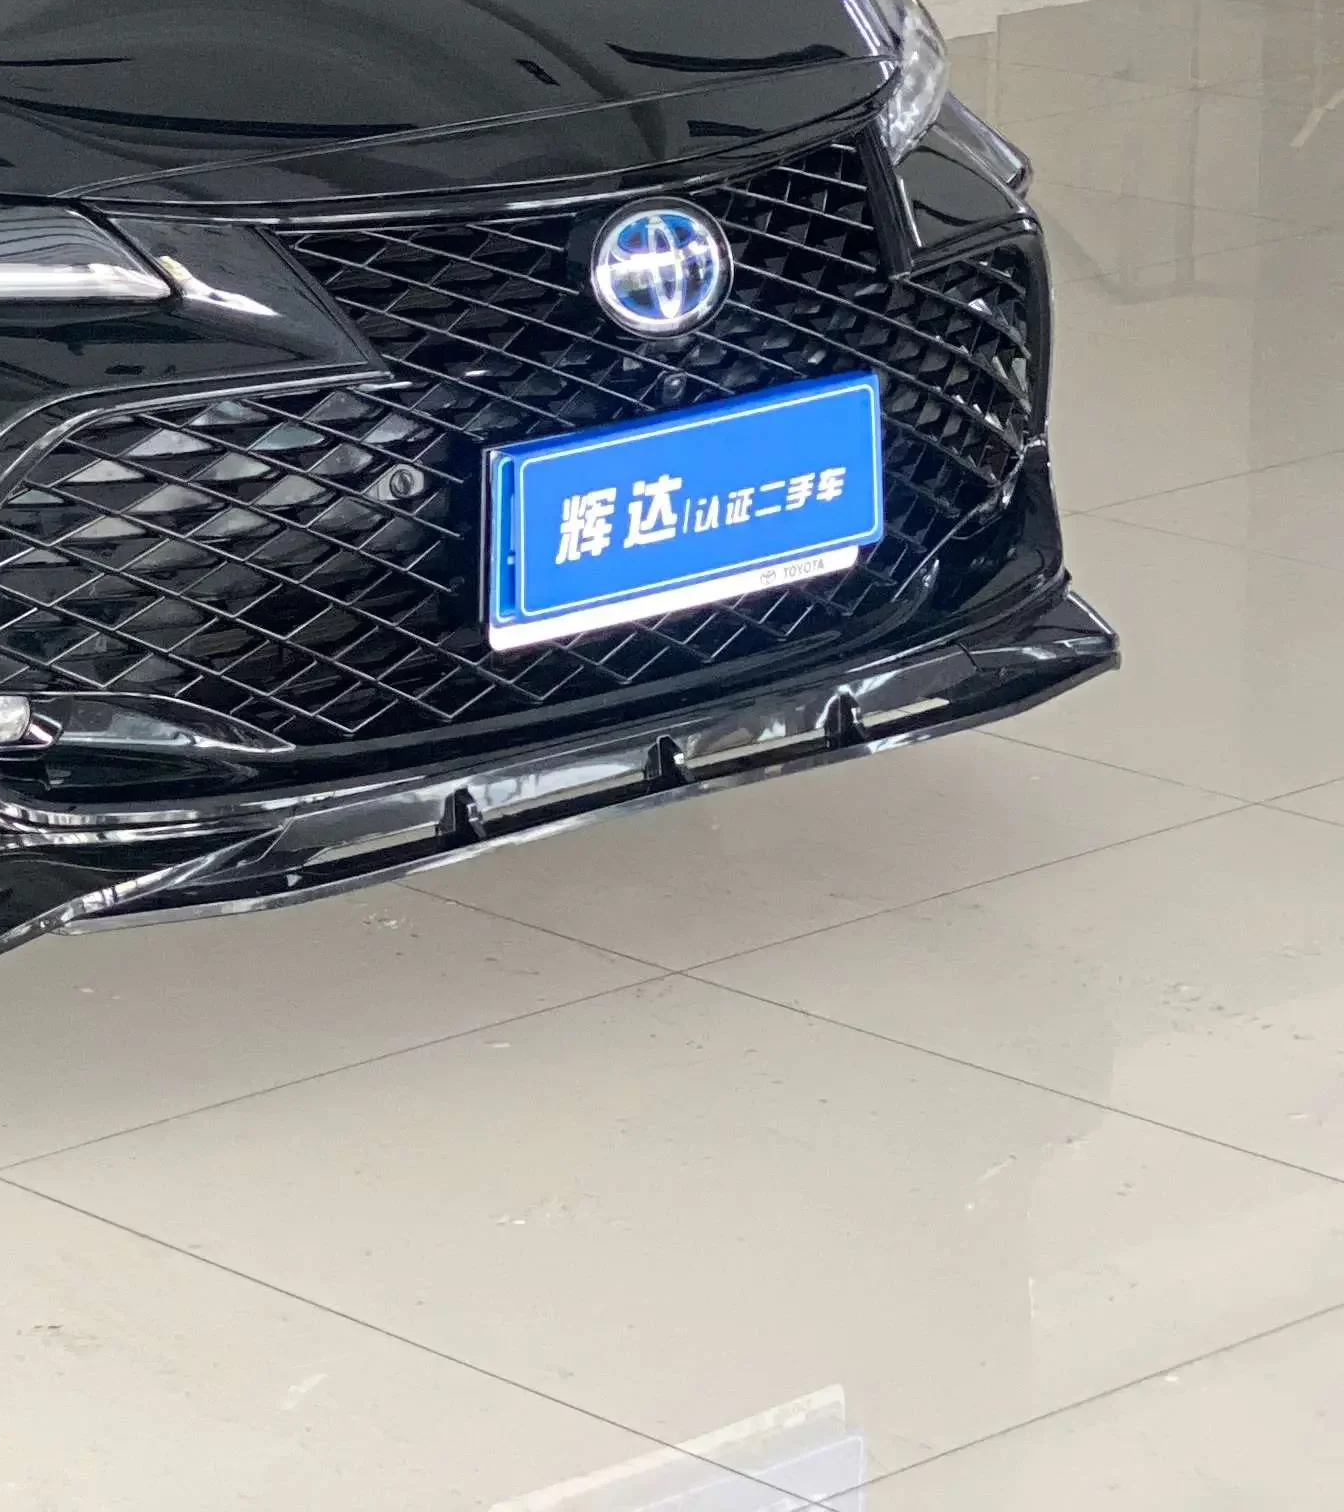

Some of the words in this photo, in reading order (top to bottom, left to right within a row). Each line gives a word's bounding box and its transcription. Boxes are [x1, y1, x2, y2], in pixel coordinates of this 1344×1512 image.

[555, 474, 683, 565] 辉达
[693, 467, 847, 533] 认证二手车
[783, 558, 825, 578] TOYOTA
